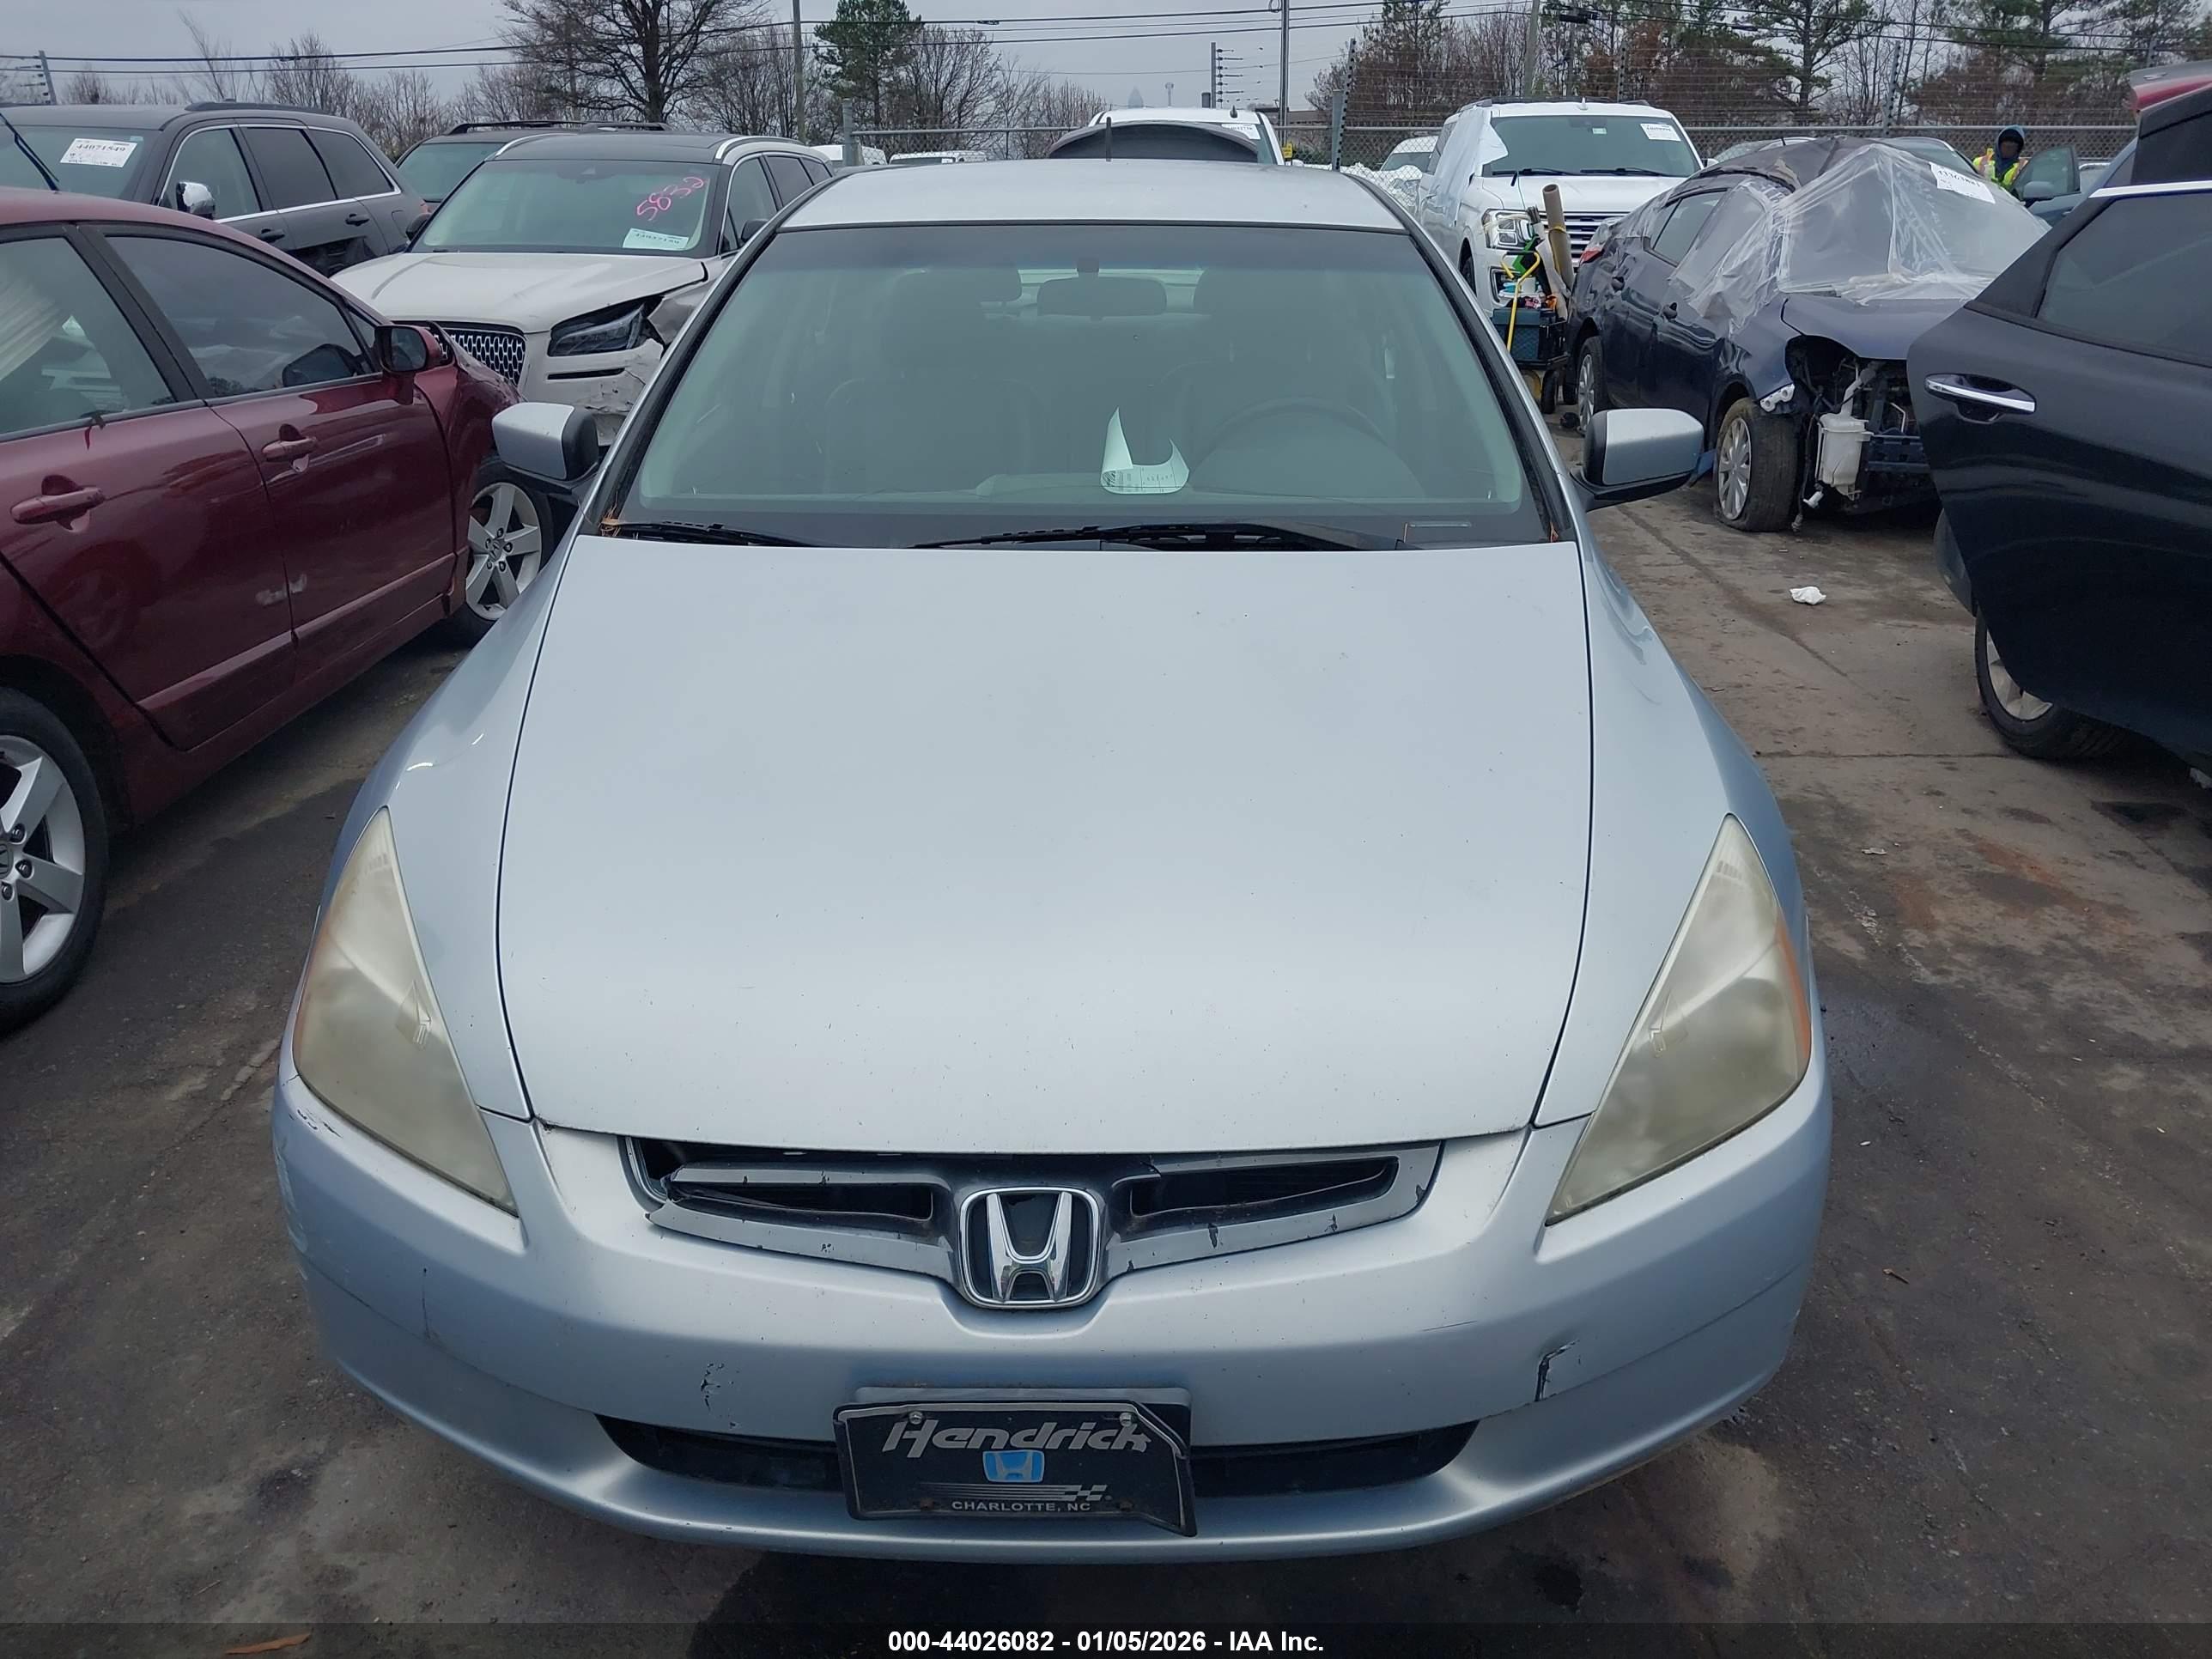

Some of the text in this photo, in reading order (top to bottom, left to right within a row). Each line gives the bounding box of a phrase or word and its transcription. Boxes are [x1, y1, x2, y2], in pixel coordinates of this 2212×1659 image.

[882, 1418, 1152, 1458] Hendrick
[951, 1500, 1092, 1512] CHARLOTTE, NC
